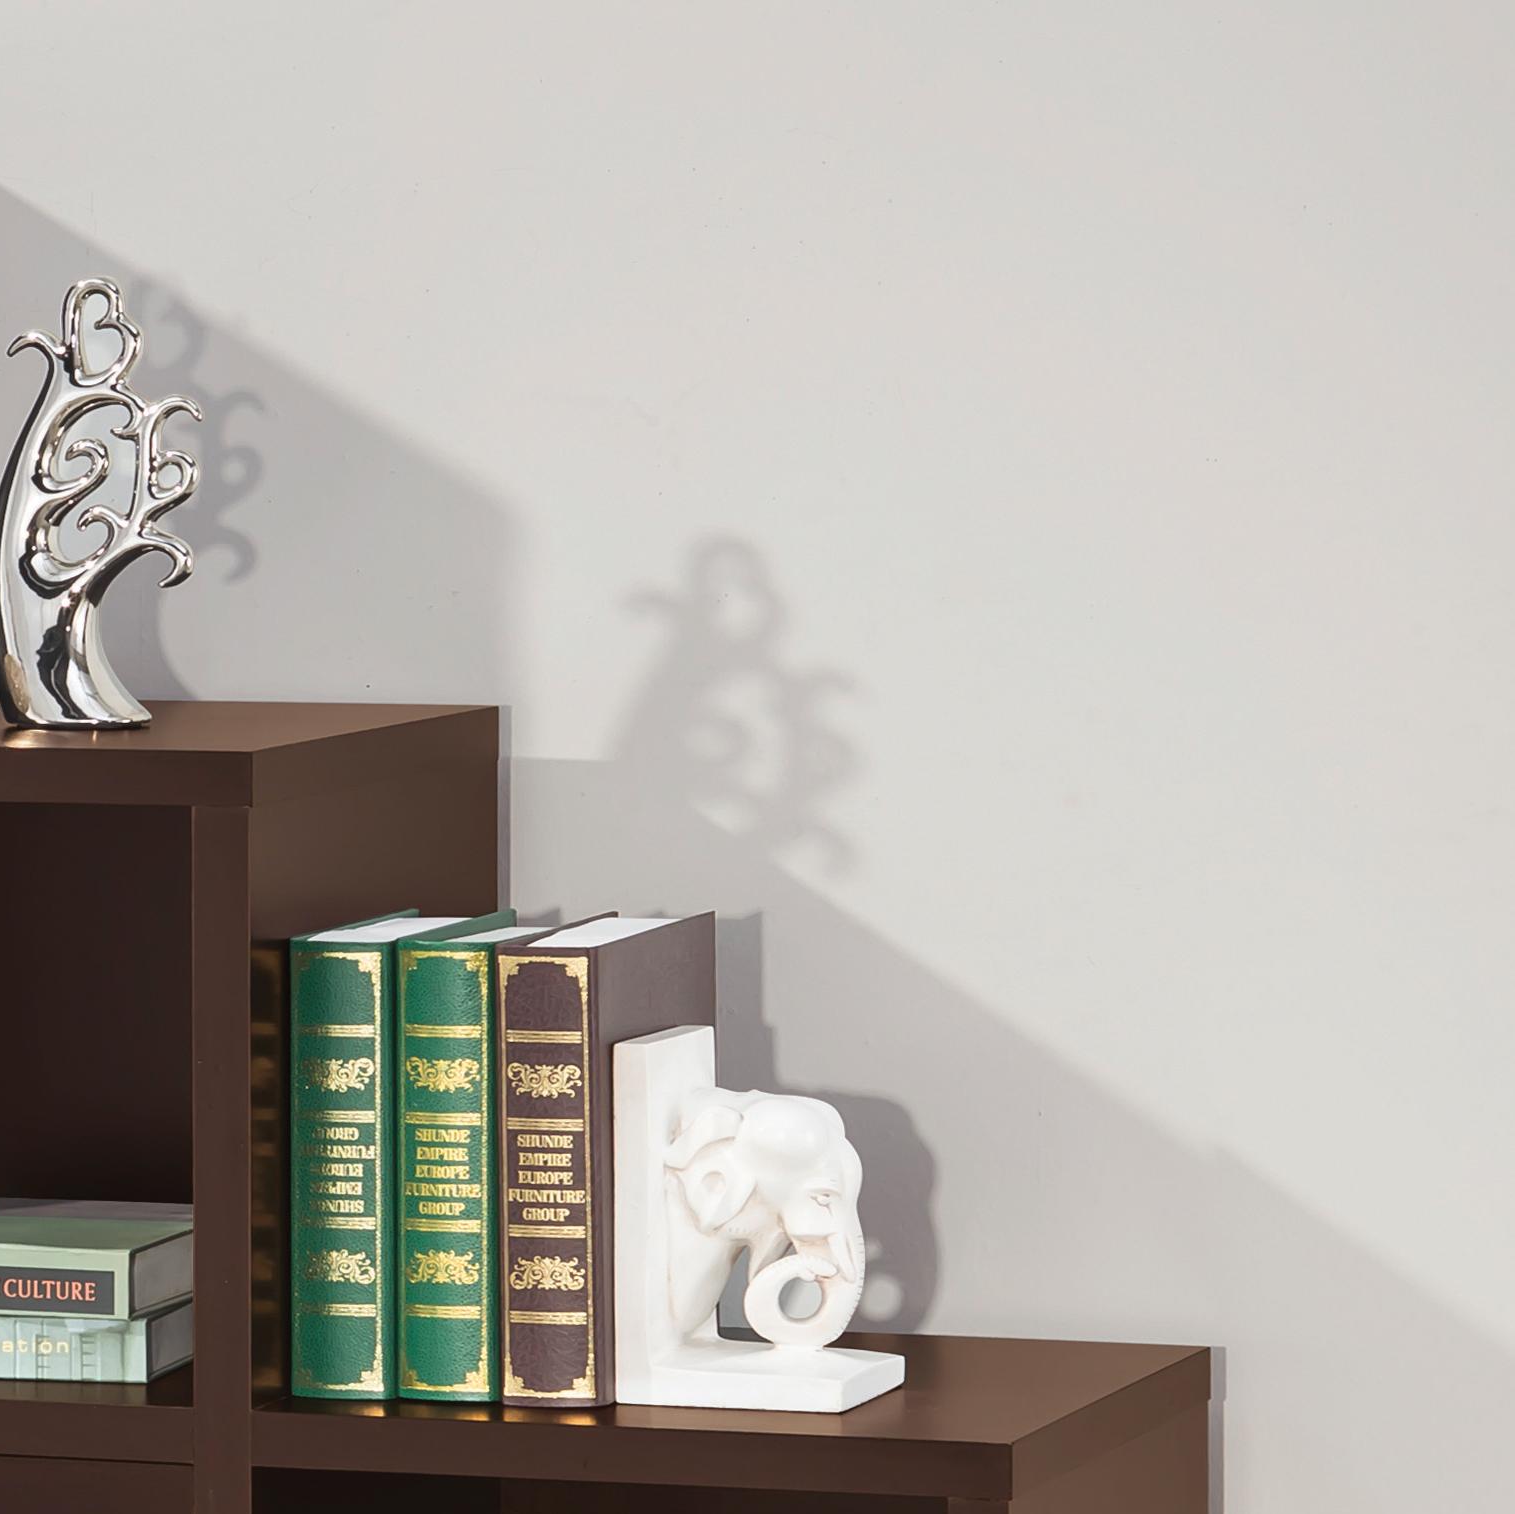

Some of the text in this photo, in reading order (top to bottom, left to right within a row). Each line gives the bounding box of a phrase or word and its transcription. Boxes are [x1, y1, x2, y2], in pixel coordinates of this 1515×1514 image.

[414, 1128, 471, 1143] SHUNDE
[516, 1134, 574, 1149] SHUNDE
[416, 1147, 469, 1161] EMPIRE
[518, 1153, 572, 1167] EMPIRE
[414, 1165, 470, 1179] EUROPE
[518, 1171, 574, 1185] EUROPE
[405, 1183, 481, 1198] FURNITURE
[508, 1189, 586, 1204] FURNITURE
[418, 1201, 466, 1216] GROUP
[521, 1208, 570, 1222] GROUP
[3, 1277, 97, 1302] CULTURE
